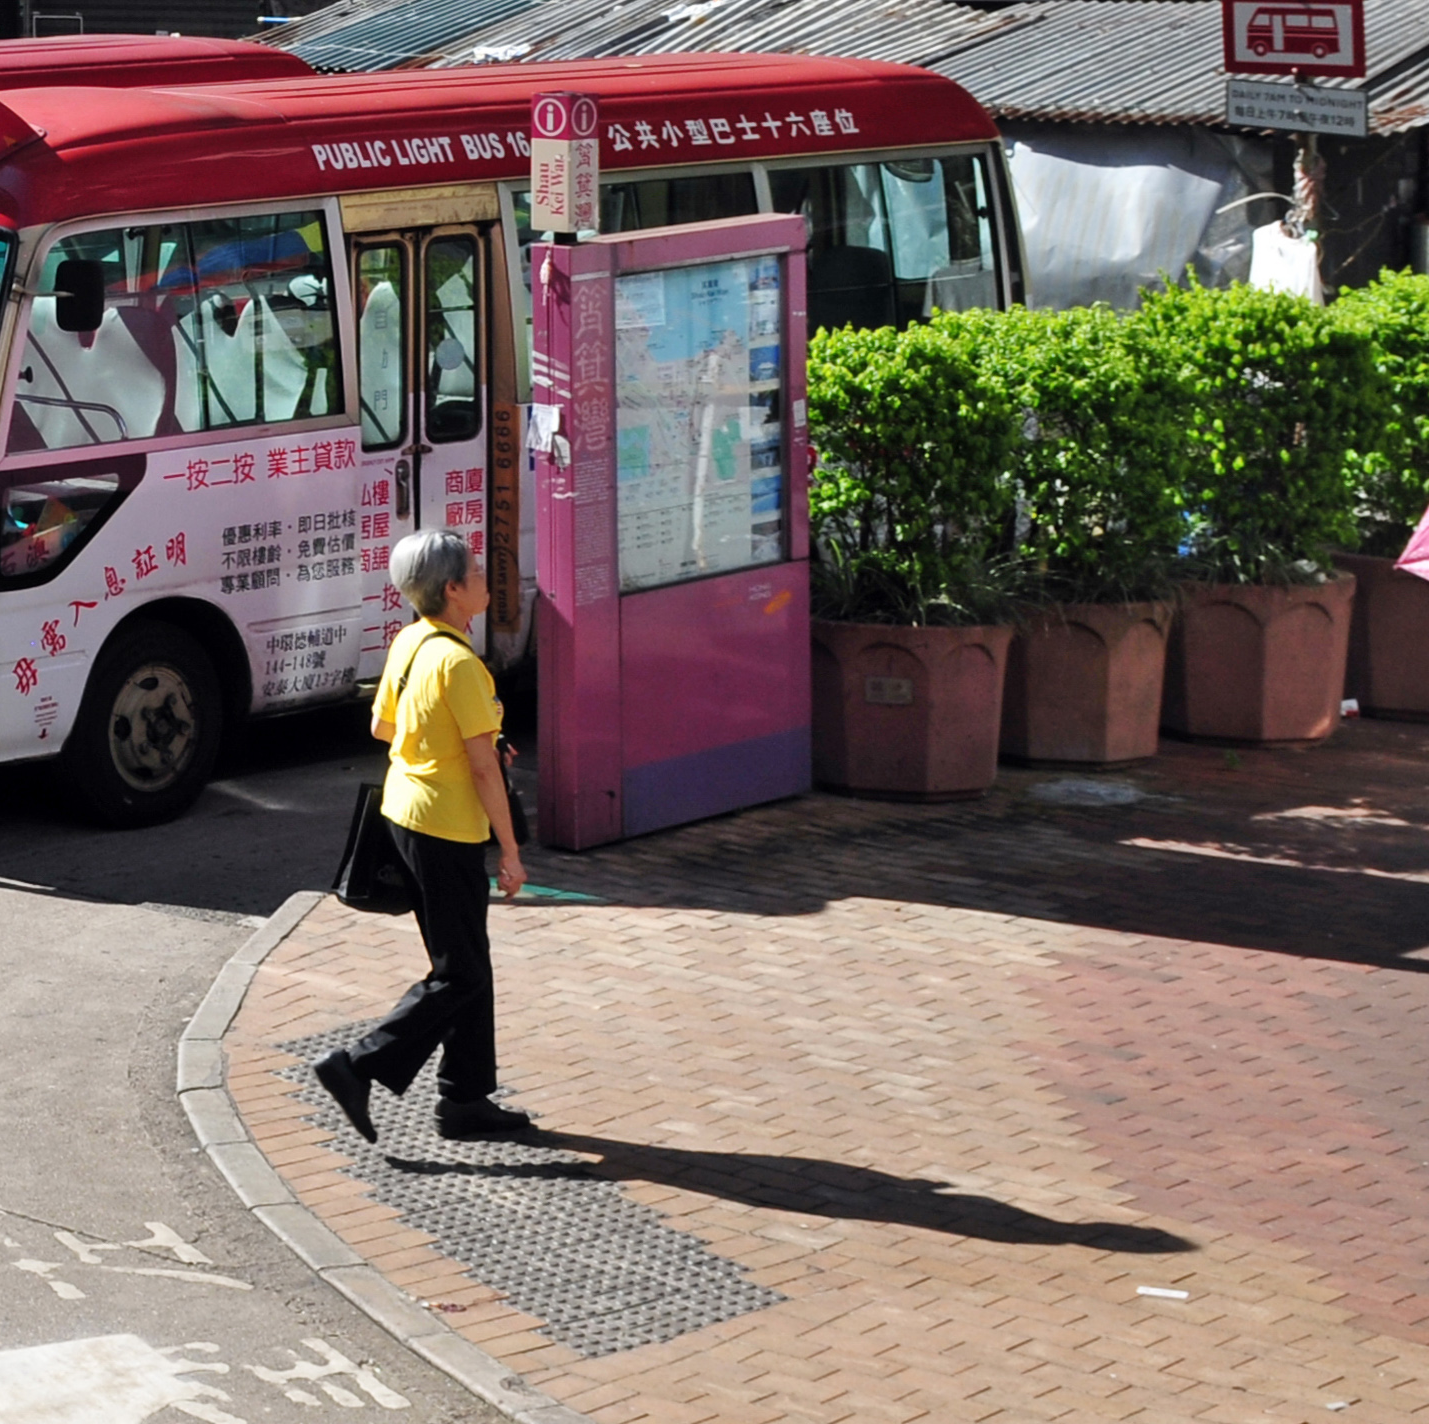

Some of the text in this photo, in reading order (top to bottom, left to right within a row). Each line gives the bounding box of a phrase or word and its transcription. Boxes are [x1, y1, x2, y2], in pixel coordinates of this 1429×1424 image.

[607, 109, 860, 152] 公共小型巴士十六座位
[312, 130, 531, 172] PUBLIC LIGHT BUS 16
[535, 162, 550, 207] Shau
[550, 190, 565, 217] Kei
[163, 438, 356, 492] 一按二按 業主貸款
[445, 468, 483, 496] 商廈
[495, 410, 511, 543] 2751 6666
[445, 499, 483, 526] 廠房
[266, 626, 347, 654] 中環德輔道中
[265, 651, 326, 675] 144-148號
